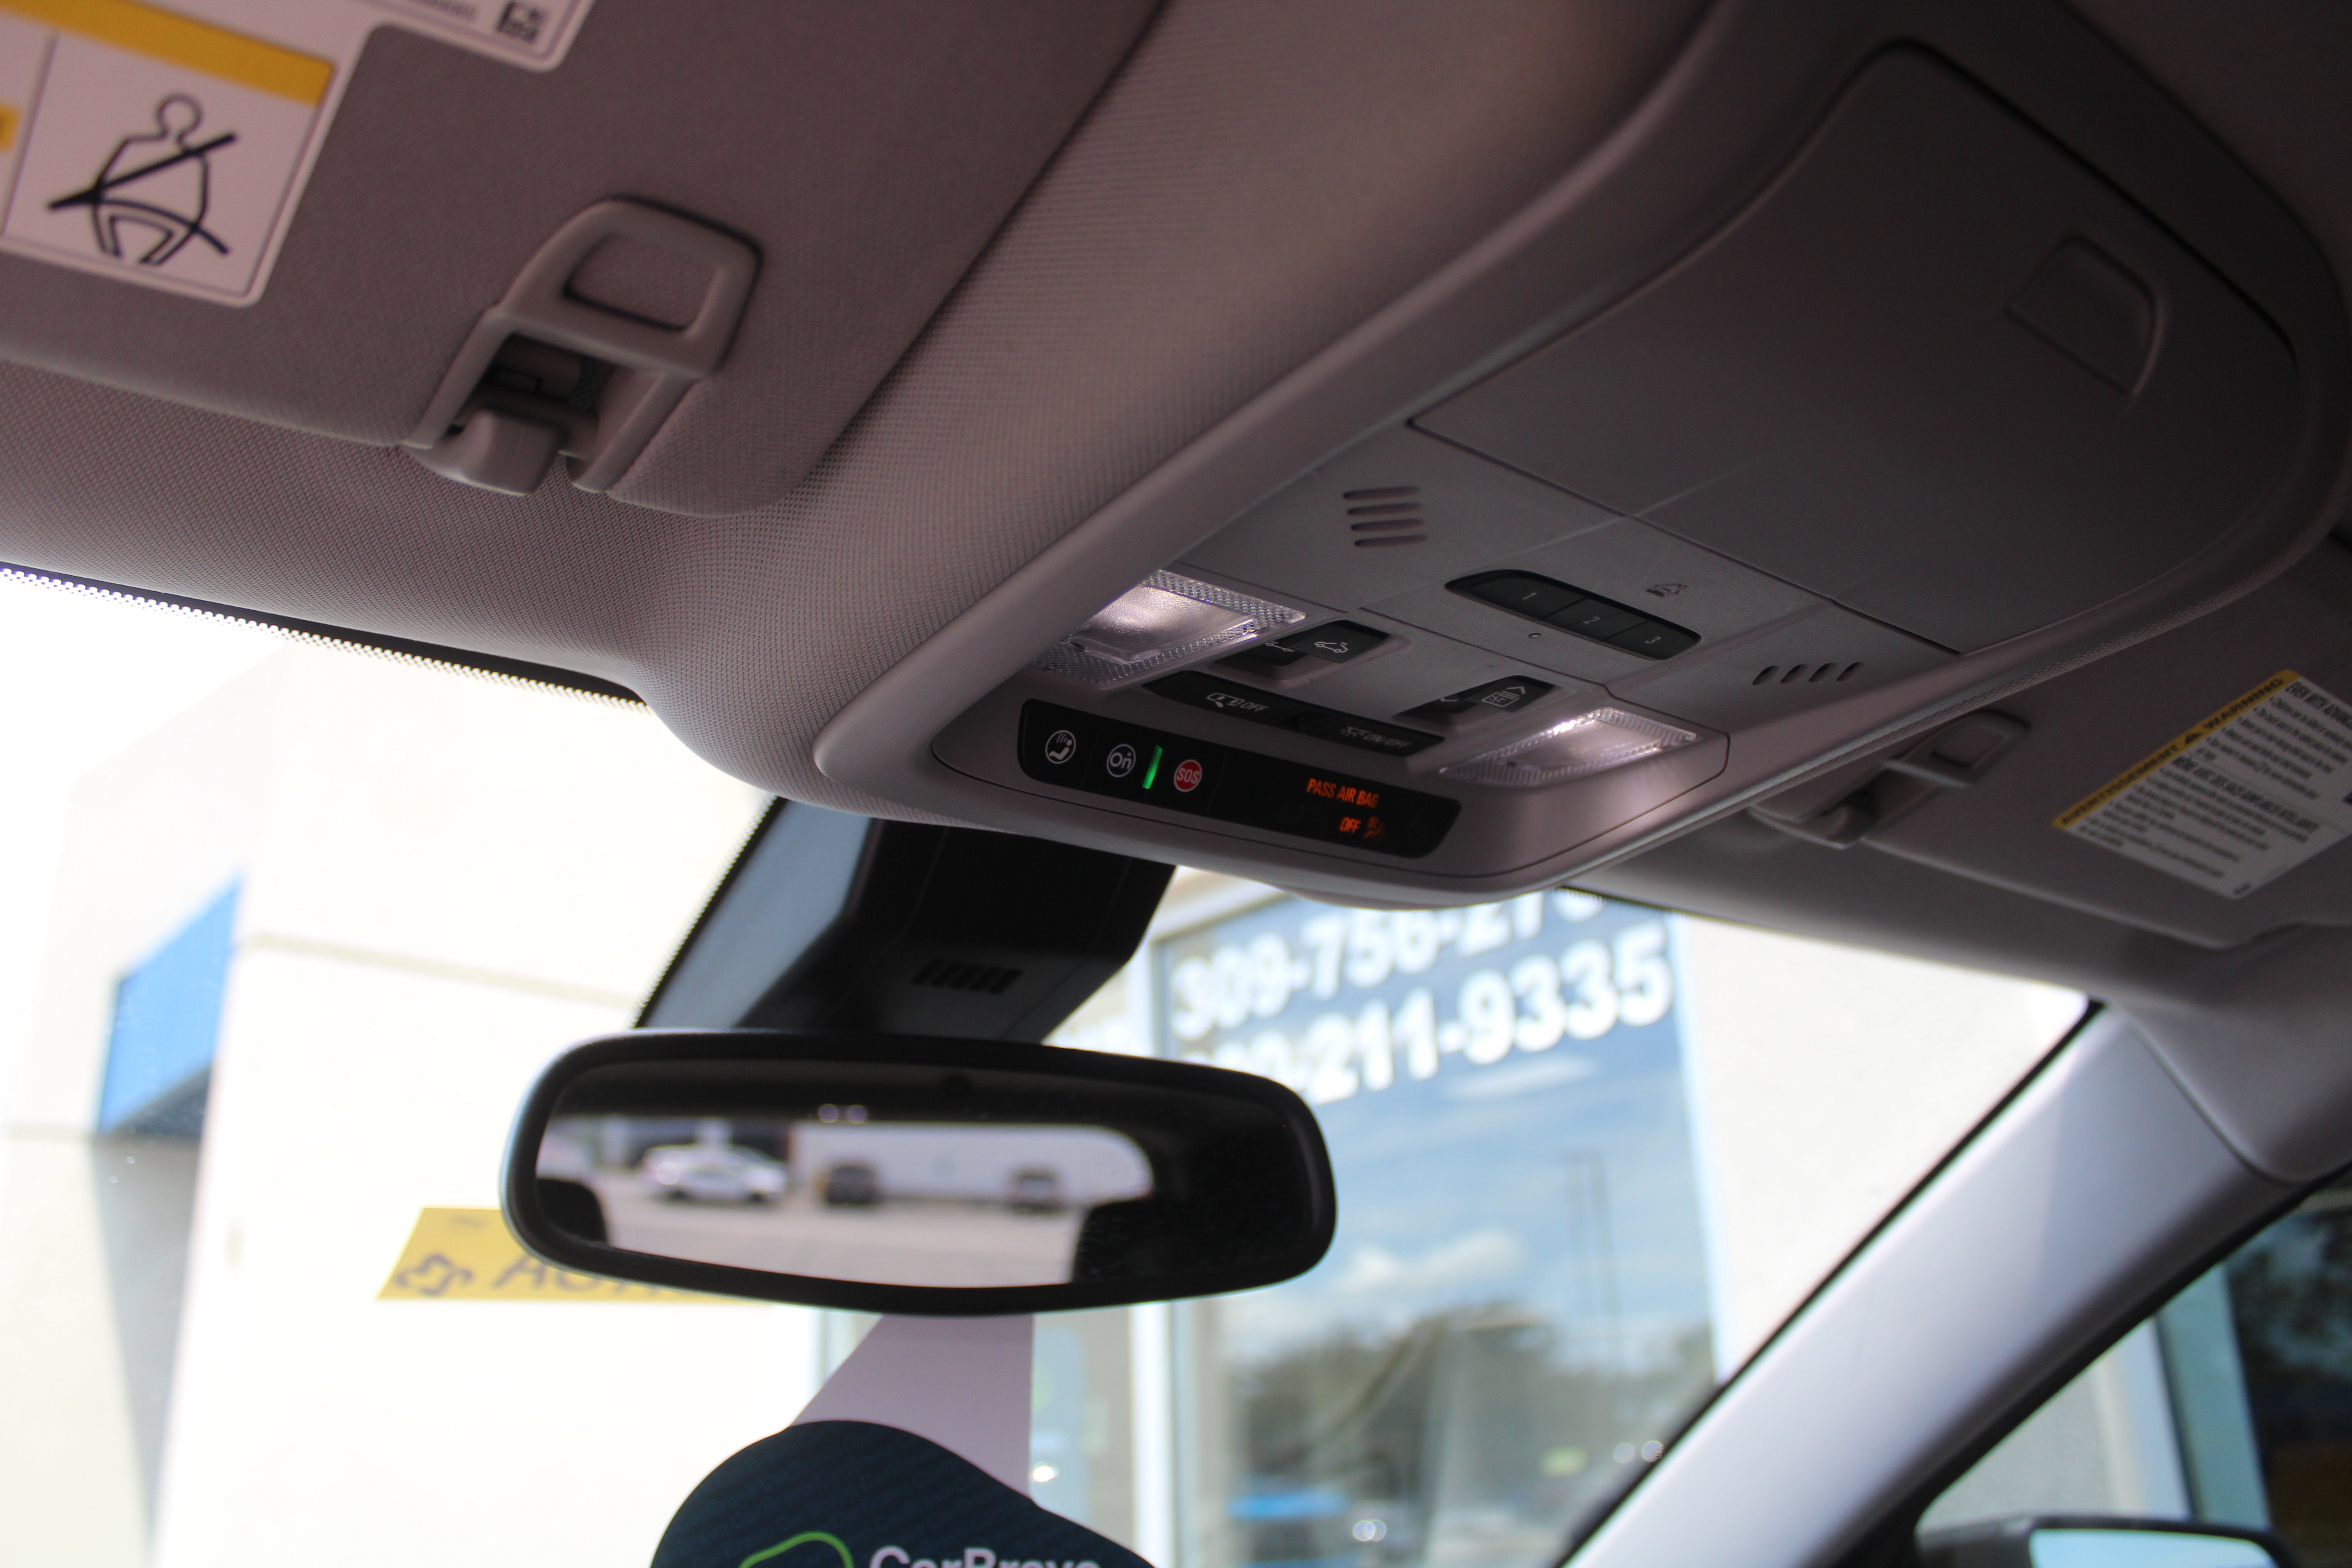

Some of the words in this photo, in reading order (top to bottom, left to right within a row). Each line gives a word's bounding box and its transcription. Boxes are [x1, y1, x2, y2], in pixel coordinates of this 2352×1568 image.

[1240, 702, 1269, 712] OFF
[1176, 768, 1200, 784] SOS
[1306, 777, 1337, 798] PASS
[1336, 786, 1357, 804] AIR
[1356, 789, 1380, 809] BAG
[1339, 816, 1361, 834] OFF
[1180, 917, 1674, 1105] 0-211-9335
